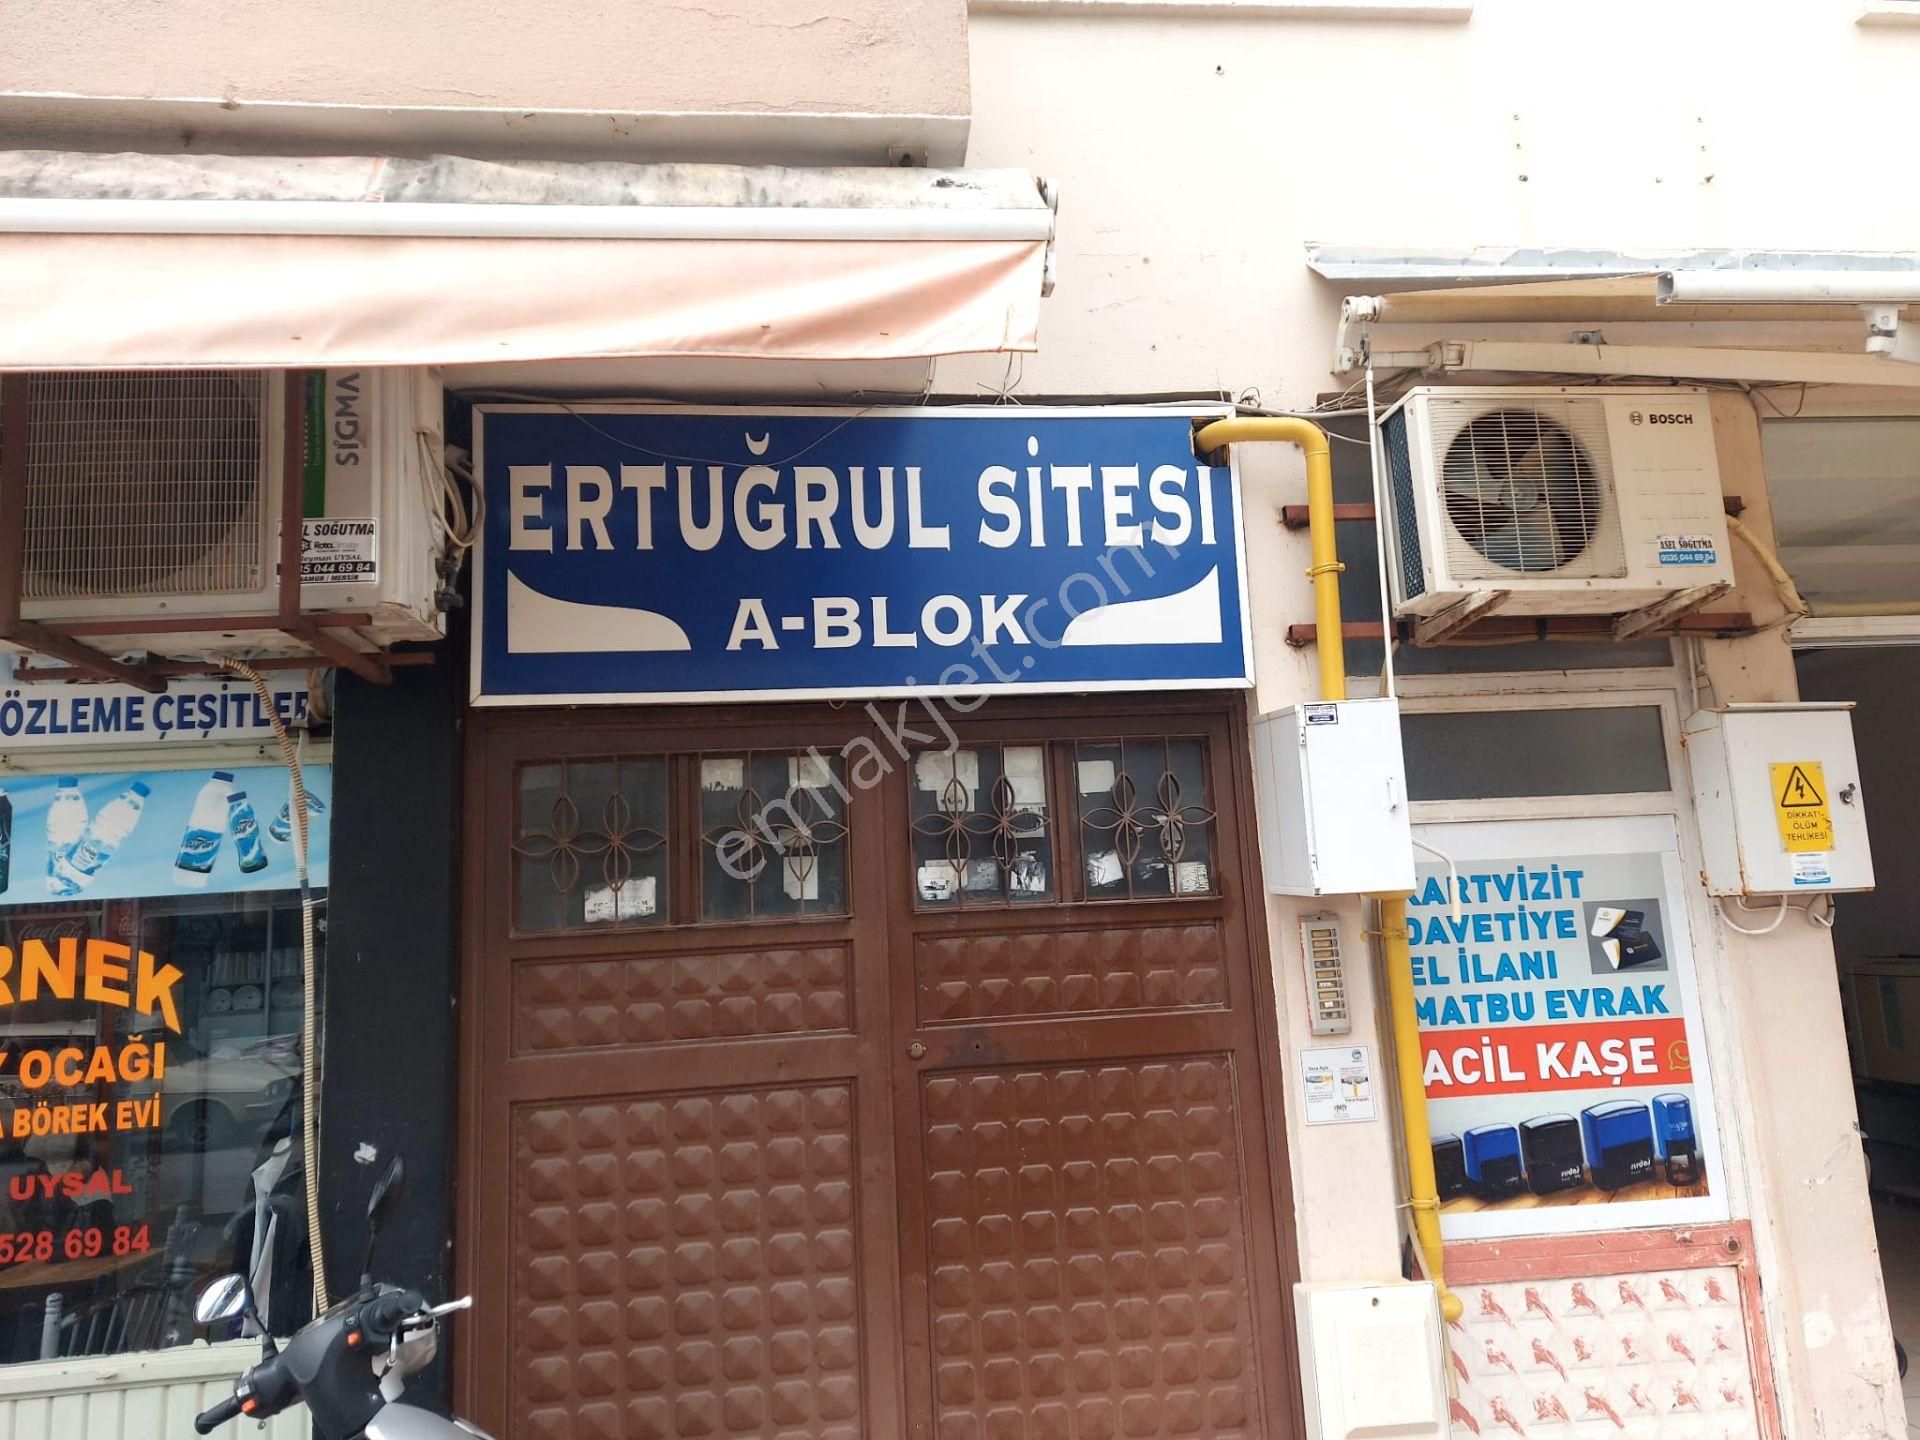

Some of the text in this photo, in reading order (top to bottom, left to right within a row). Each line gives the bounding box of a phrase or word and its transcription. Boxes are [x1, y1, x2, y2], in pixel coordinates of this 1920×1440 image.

[1649, 413, 1694, 425] BOSCH
[508, 432, 951, 554] ERTUĞRUL
[314, 522, 375, 536] SOĞUTMA
[313, 563, 335, 573] 044
[338, 563, 353, 572] 69
[356, 562, 371, 572] 84
[724, 593, 1033, 651] A-BLOK
[1406, 904, 1578, 946] DAVETİYE
[1410, 947, 1558, 986] EL İLANI
[1415, 984, 1670, 1026] MATBU EVRAK
[19, 1035, 166, 1089] OCAĞI
[1423, 1035, 1659, 1087] ACİL KAŞE
[12, 1101, 109, 1138] BÖREK
[116, 1092, 161, 1130] EVİ
[10, 1169, 133, 1200] UYSAL
[0, 1224, 150, 1264] 528 69 84
